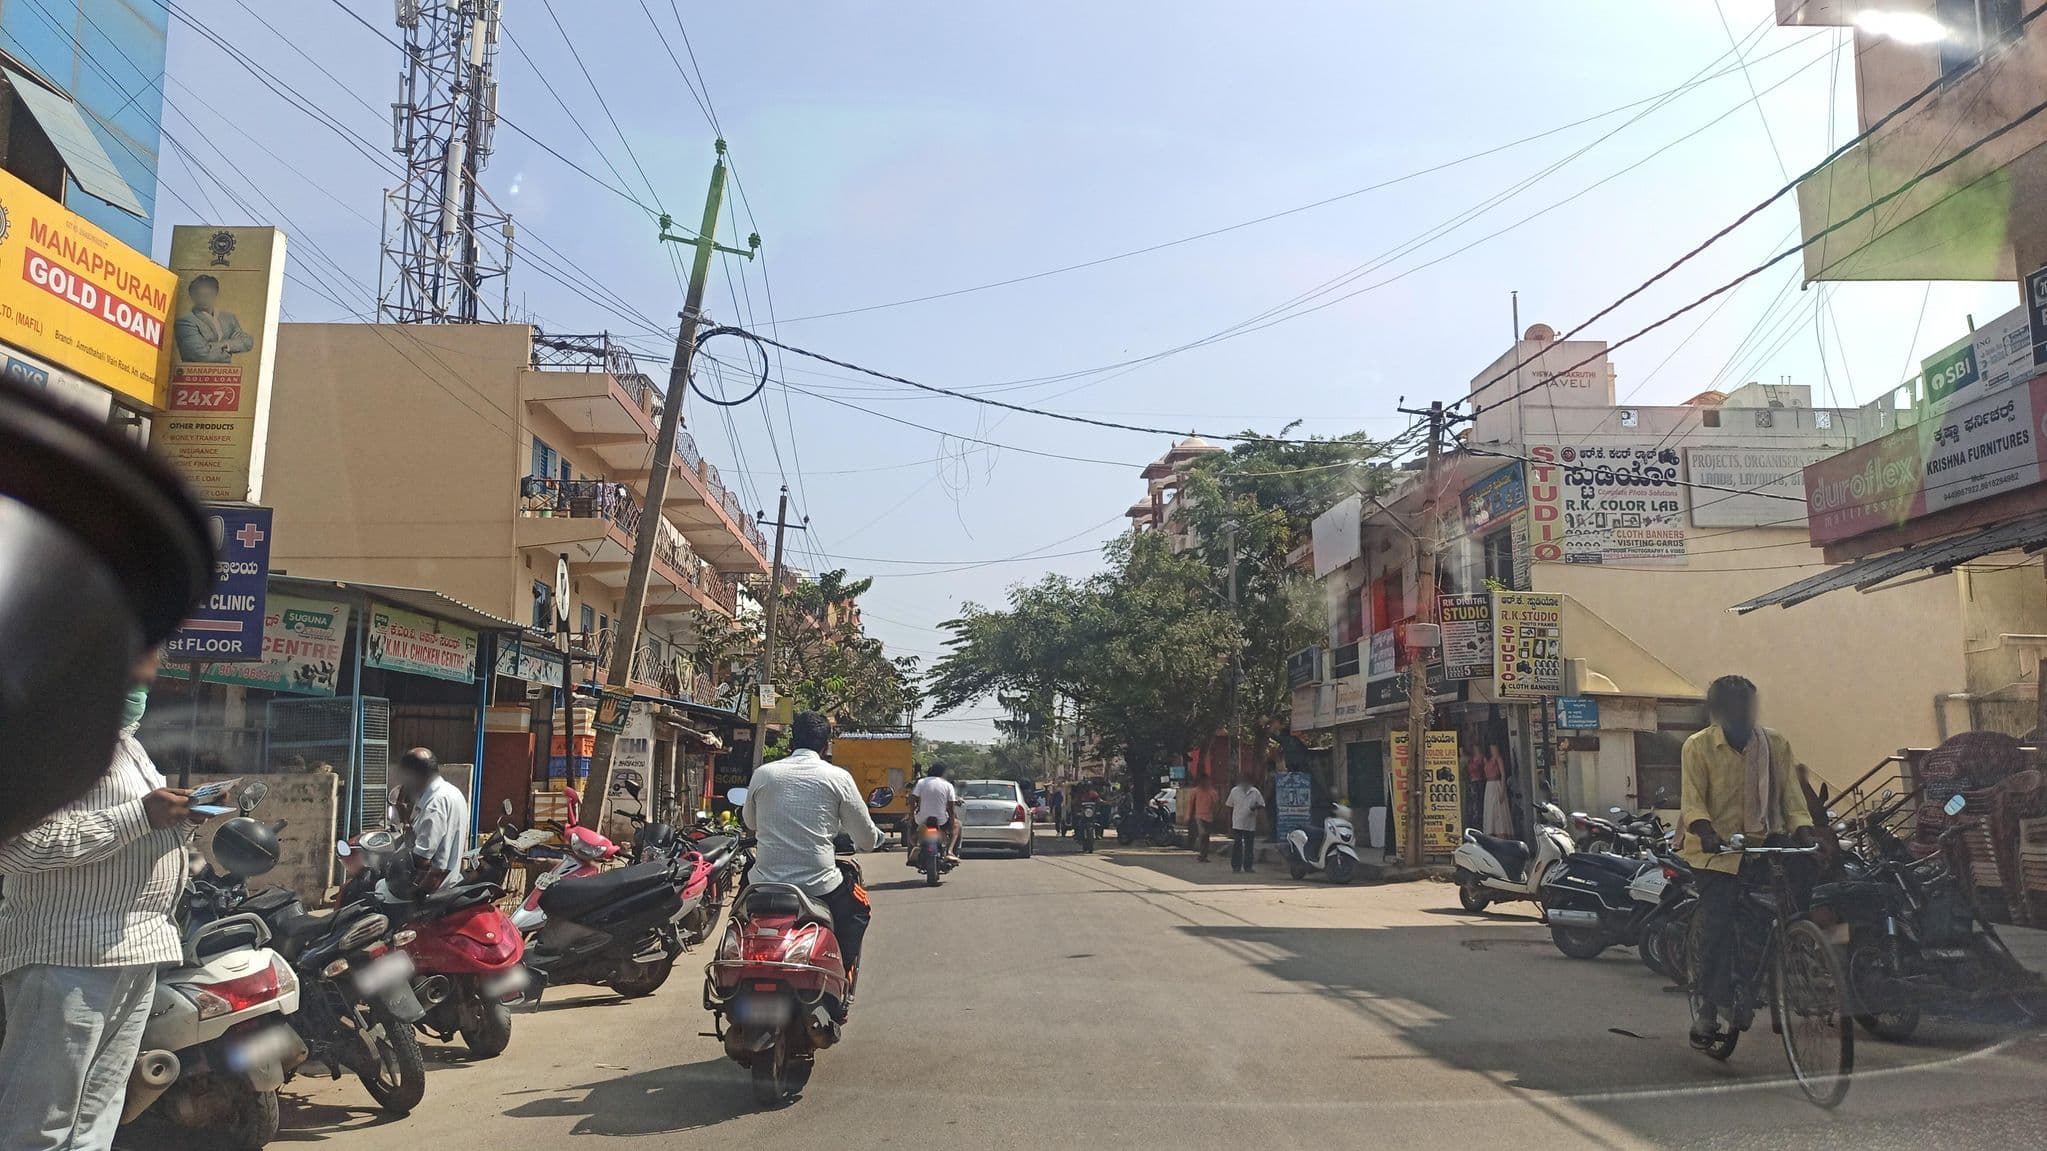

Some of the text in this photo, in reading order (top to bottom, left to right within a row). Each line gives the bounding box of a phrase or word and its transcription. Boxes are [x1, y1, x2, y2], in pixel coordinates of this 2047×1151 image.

[30, 217, 167, 314] MANAPPURAM
[30, 256, 161, 346] GOLD LOAN
[15, 312, 44, 336] (MAFIL)
[1945, 358, 1971, 384] SBI
[176, 390, 225, 406] 24x7
[169, 422, 235, 431] OTHER PRODUCTS
[1926, 429, 2030, 476] KRISHNA FURNITURES
[1811, 455, 1916, 513] duroflex
[1531, 446, 1561, 561] STUDIO
[1565, 499, 1679, 512] R.K. COLOR LAB
[1616, 529, 1684, 539] CLOTH BANNERS
[1617, 539, 1684, 547] VISITING CARDS
[209, 594, 256, 612] CLINIC
[1456, 597, 1488, 605] DIGITAL
[288, 612, 328, 625] SUGUNA
[1443, 605, 1489, 621] STUDIO
[186, 638, 243, 653] FLOOR
[262, 636, 340, 661] CENTRE
[385, 638, 408, 659] K.M.V.
[410, 643, 440, 665] CHICKEN
[440, 650, 465, 670] CENTRE
[1501, 625, 1516, 681] STUDIO
[1464, 665, 1472, 676] 5
